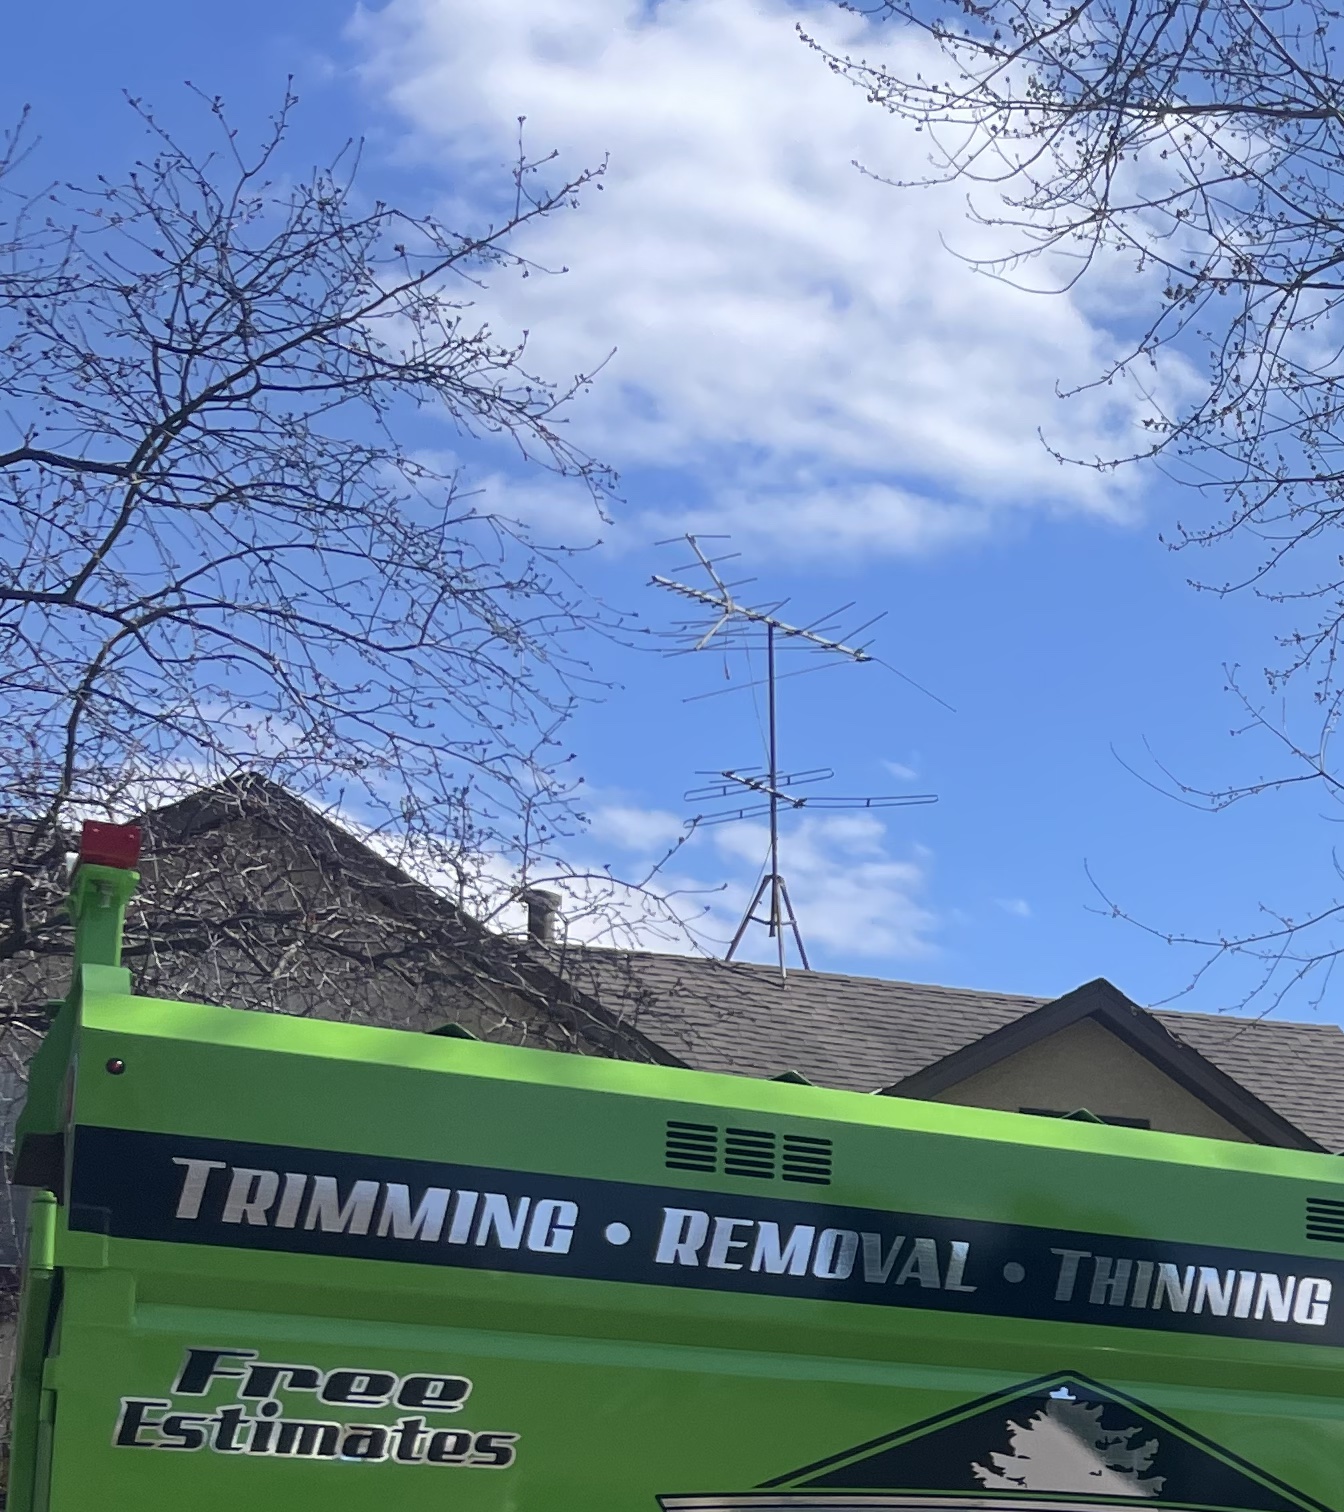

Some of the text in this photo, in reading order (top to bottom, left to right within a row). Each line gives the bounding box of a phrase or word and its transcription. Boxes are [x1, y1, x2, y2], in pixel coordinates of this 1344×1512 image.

[172, 1156, 578, 1255] TRIMMING
[655, 1207, 977, 1294] REMOVAL
[1051, 1248, 1332, 1327] THINNING
[171, 1346, 473, 1413] Free
[111, 1396, 521, 1469] Estimates
